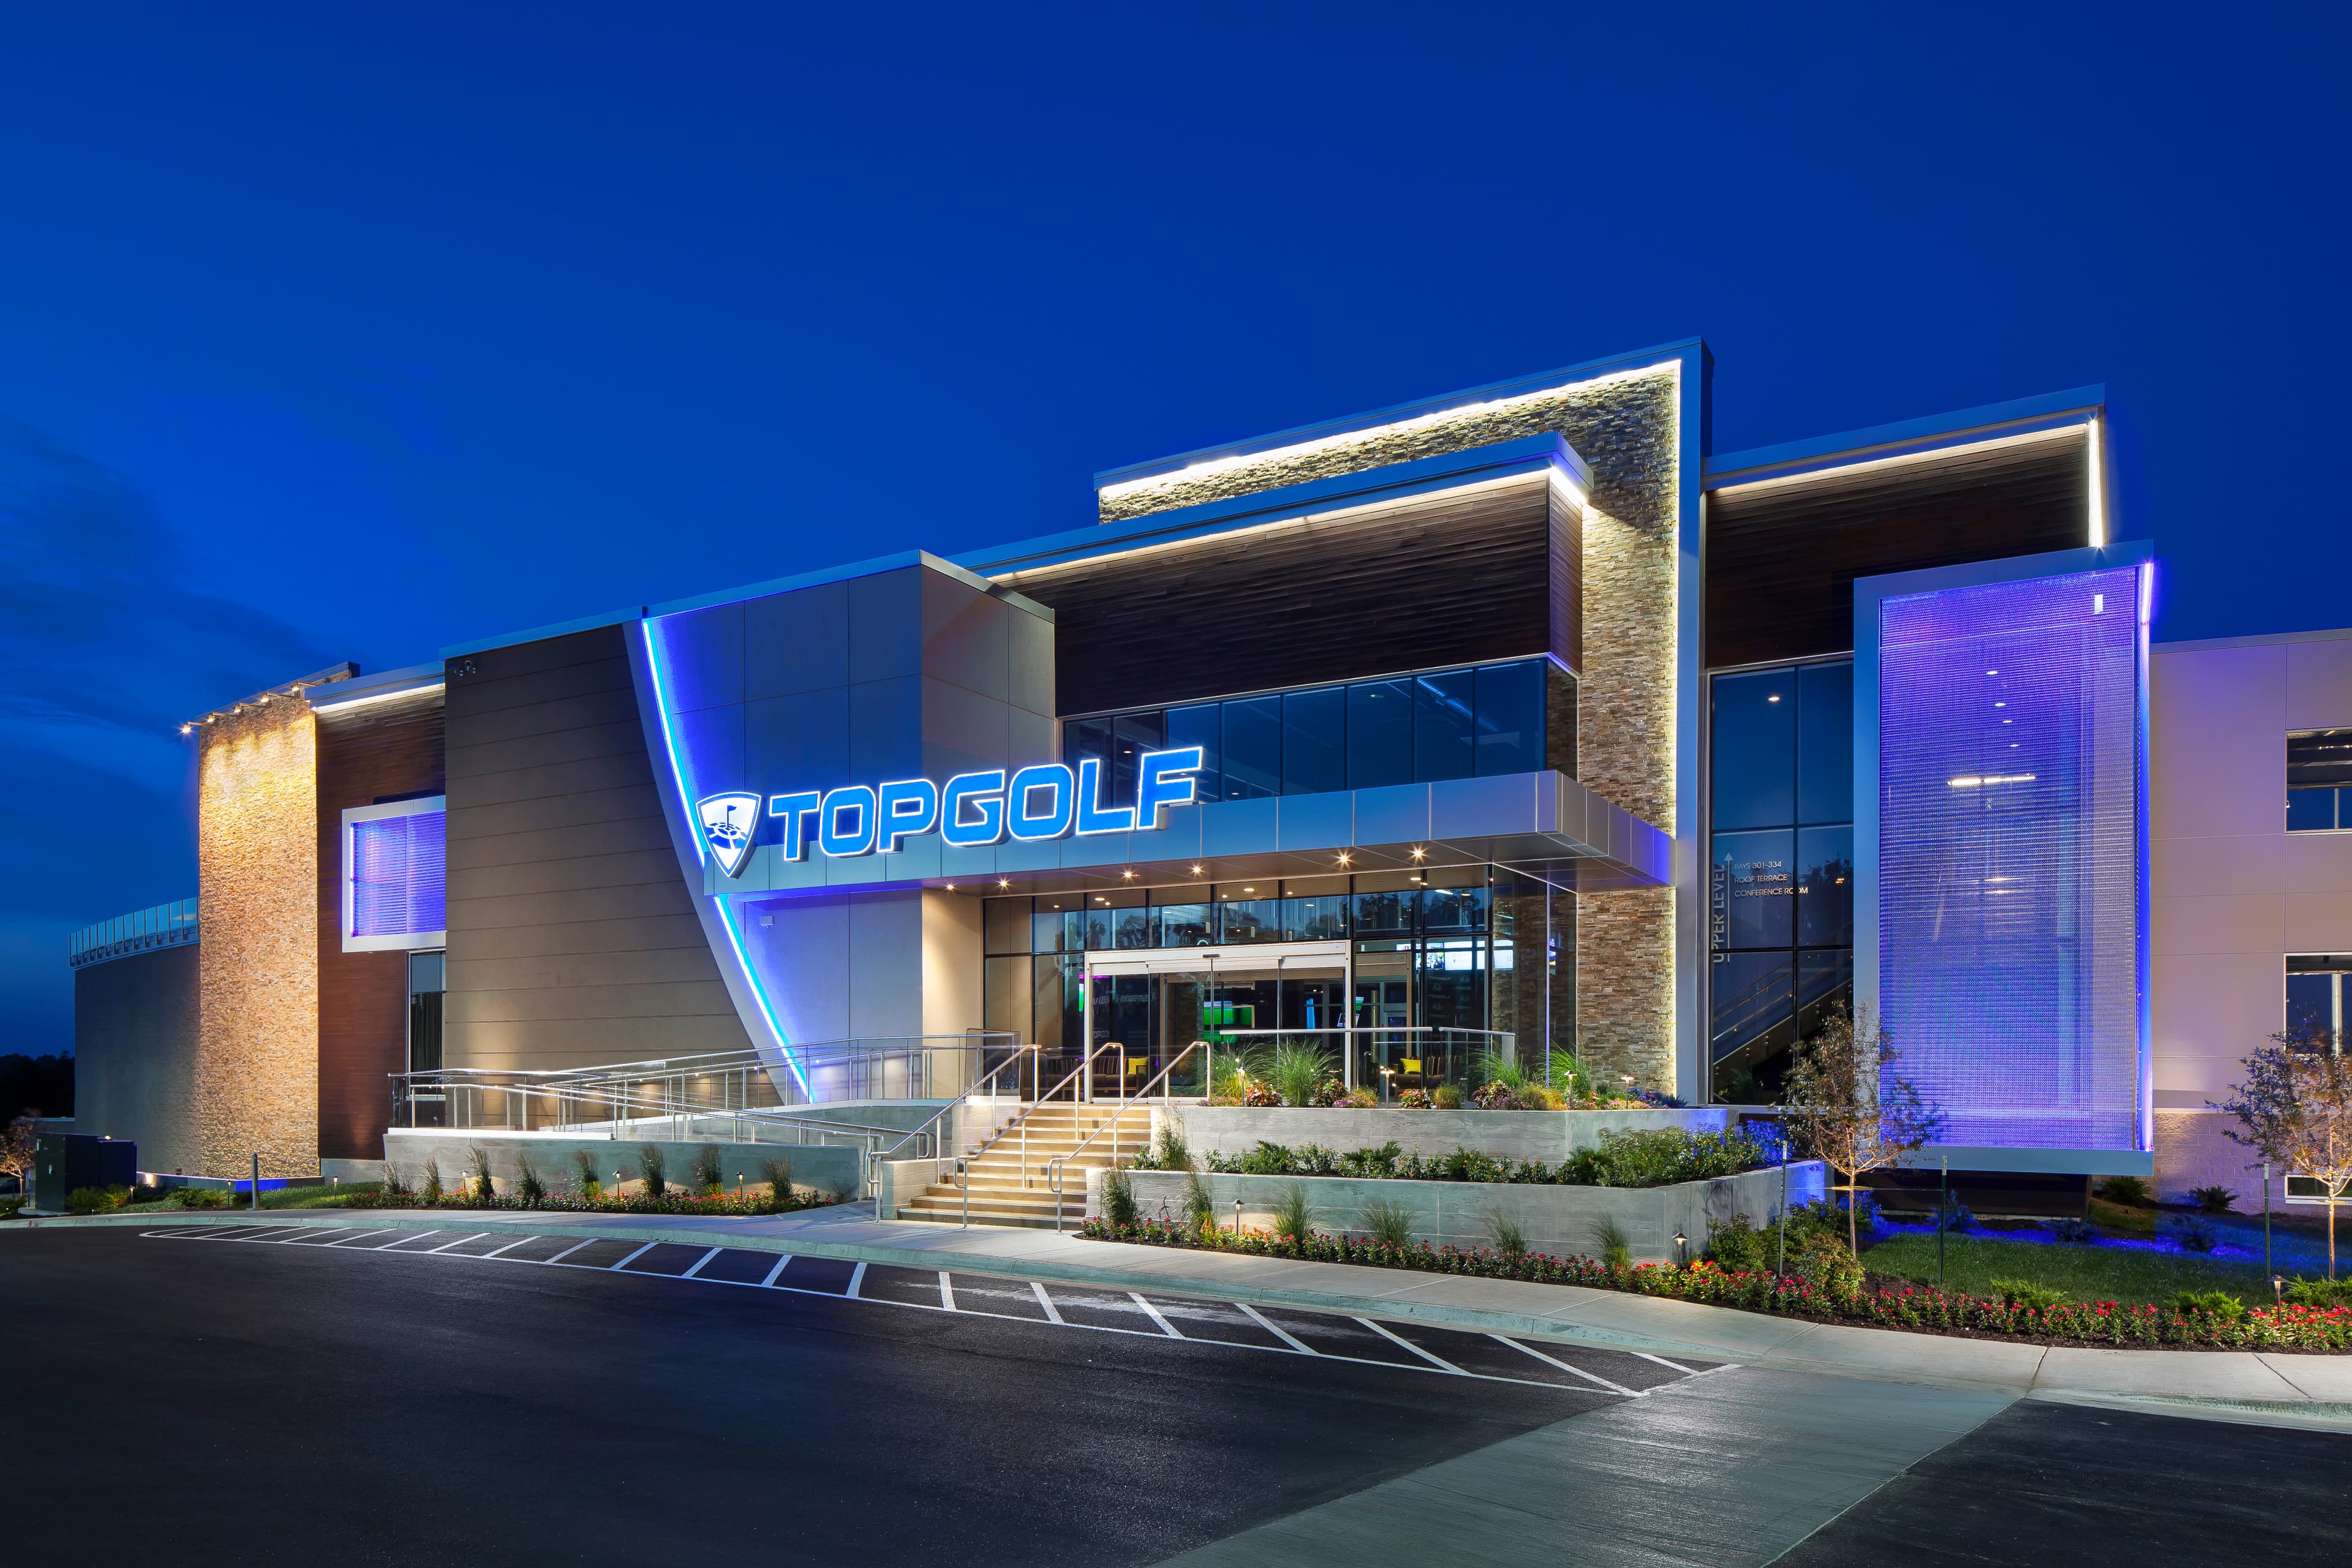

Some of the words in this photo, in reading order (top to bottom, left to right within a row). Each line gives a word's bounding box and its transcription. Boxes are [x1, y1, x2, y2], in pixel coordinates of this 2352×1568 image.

[768, 745, 1204, 862] TOPGOLF
[1752, 861, 1782, 869] 301-334
[1714, 865, 1725, 908] LEVEL
[1735, 888, 1782, 897] CONFERENCE
